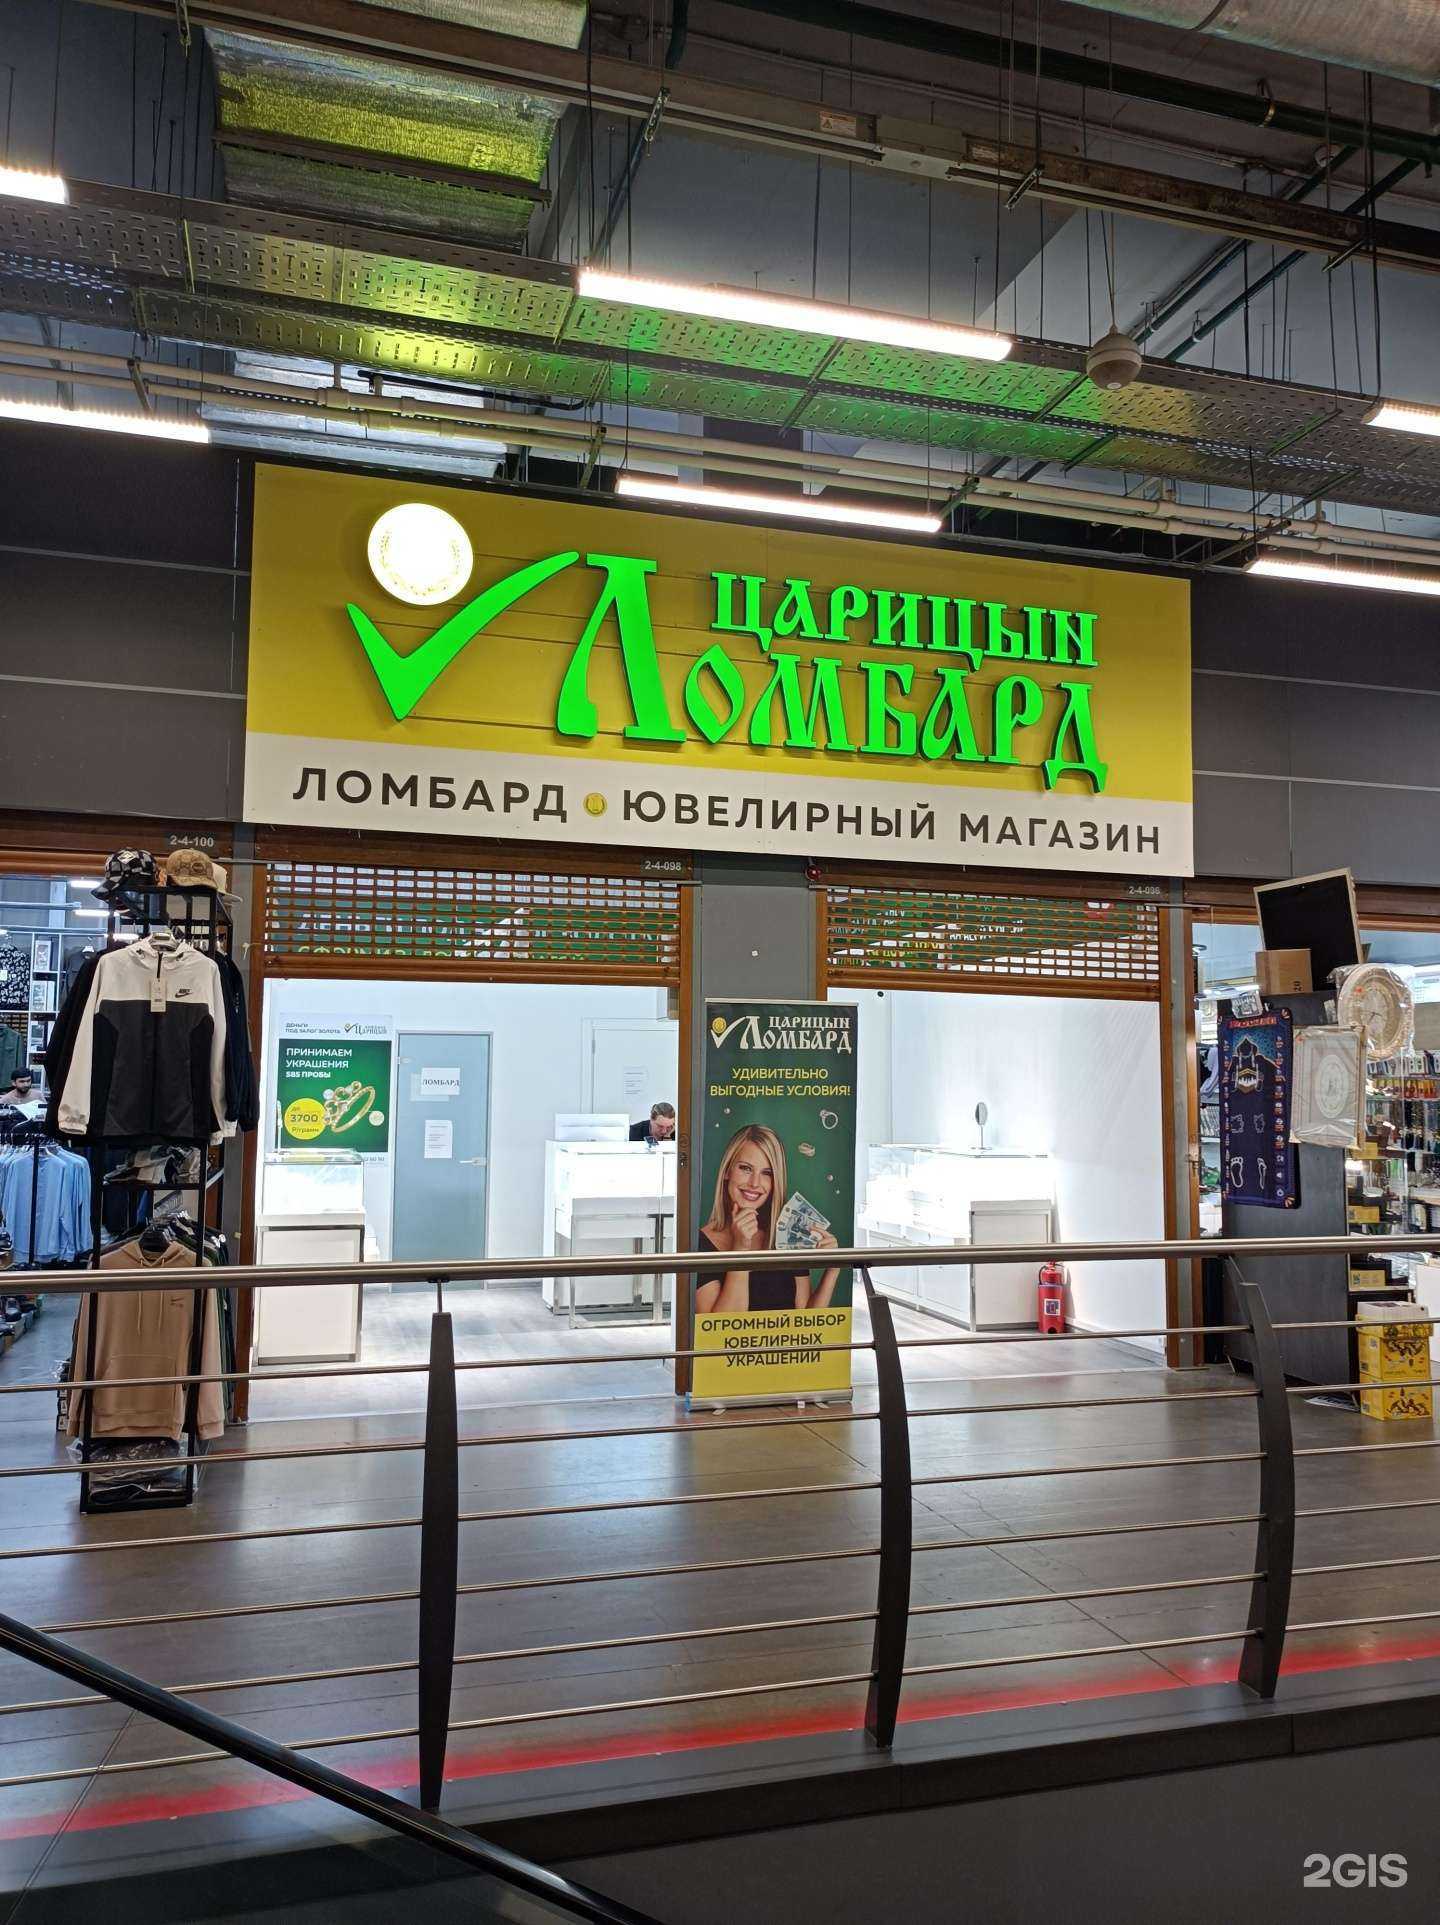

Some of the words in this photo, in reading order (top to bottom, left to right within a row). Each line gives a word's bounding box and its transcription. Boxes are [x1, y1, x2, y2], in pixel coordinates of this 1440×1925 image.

[711, 571, 1099, 671] ЦАРИЦЫН
[555, 552, 1109, 793] ЛОМБАРД
[292, 767, 568, 824] ЛОМБАРД
[622, 788, 936, 841] ЮВЕЛИРНЫЙ
[959, 812, 1160, 855] МАГАЗИН
[169, 834, 215, 848] 2-4-100
[644, 860, 683, 872] 2-4-098
[768, 1015, 850, 1031] ЦАРИЦЫН
[739, 1015, 852, 1054] ЛОМБАРД
[286, 1047, 353, 1057] ПРИНИМАЕМ
[285, 1059, 349, 1069] УКРАШЕНИЯ
[285, 1070, 301, 1078] 585
[301, 1071, 331, 1079] ПРОБЫ
[732, 1068, 829, 1081] УДИВИТЕЛЬНО
[710, 1084, 784, 1098] ВЫГОДНЫЕ
[787, 1085, 851, 1097] УСЛОВИЯ!
[290, 1114, 319, 1123] 3700
[701, 1313, 791, 1332] ОГРОМНЫЙ
[793, 1314, 846, 1328] ВЫБОР
[724, 1333, 823, 1349] ЮВЕЛИРНЫХ
